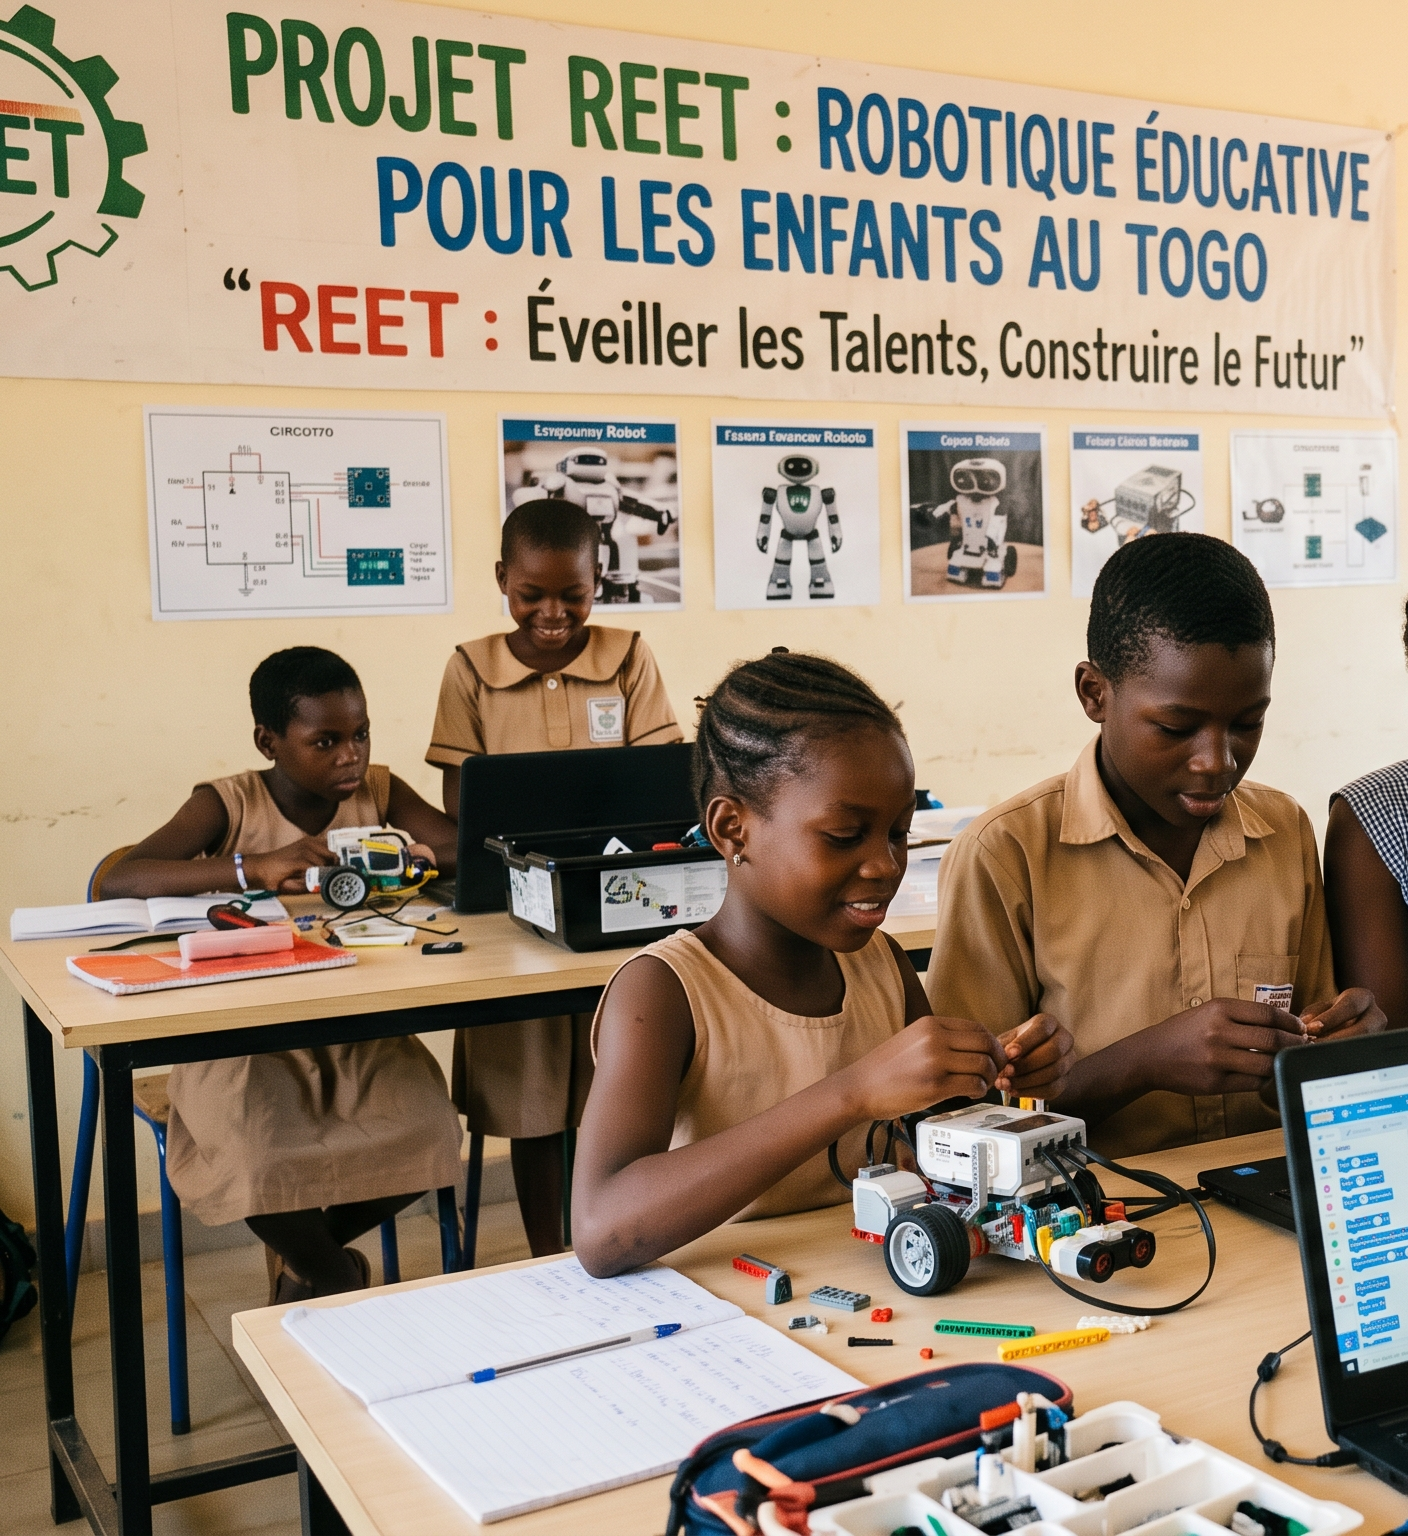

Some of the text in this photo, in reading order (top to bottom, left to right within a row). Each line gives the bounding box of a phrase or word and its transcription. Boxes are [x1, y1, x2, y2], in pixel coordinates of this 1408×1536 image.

[225, 11, 527, 141] PROJET
[567, 54, 750, 162] REET
[817, 86, 1117, 202] ROBOTIQUE
[1135, 109, 1370, 222] ÉDUCATIVE
[375, 155, 1268, 303] POUR LES ENFANTS AU TOGO
[527, 277, 719, 368] Éveiller
[738, 305, 805, 371] les
[819, 310, 989, 384] Talents,
[999, 321, 1199, 386] Construire
[1214, 331, 1241, 387] le
[269, 426, 334, 438] CIRCOT70
[606, 425, 647, 439] Robot
